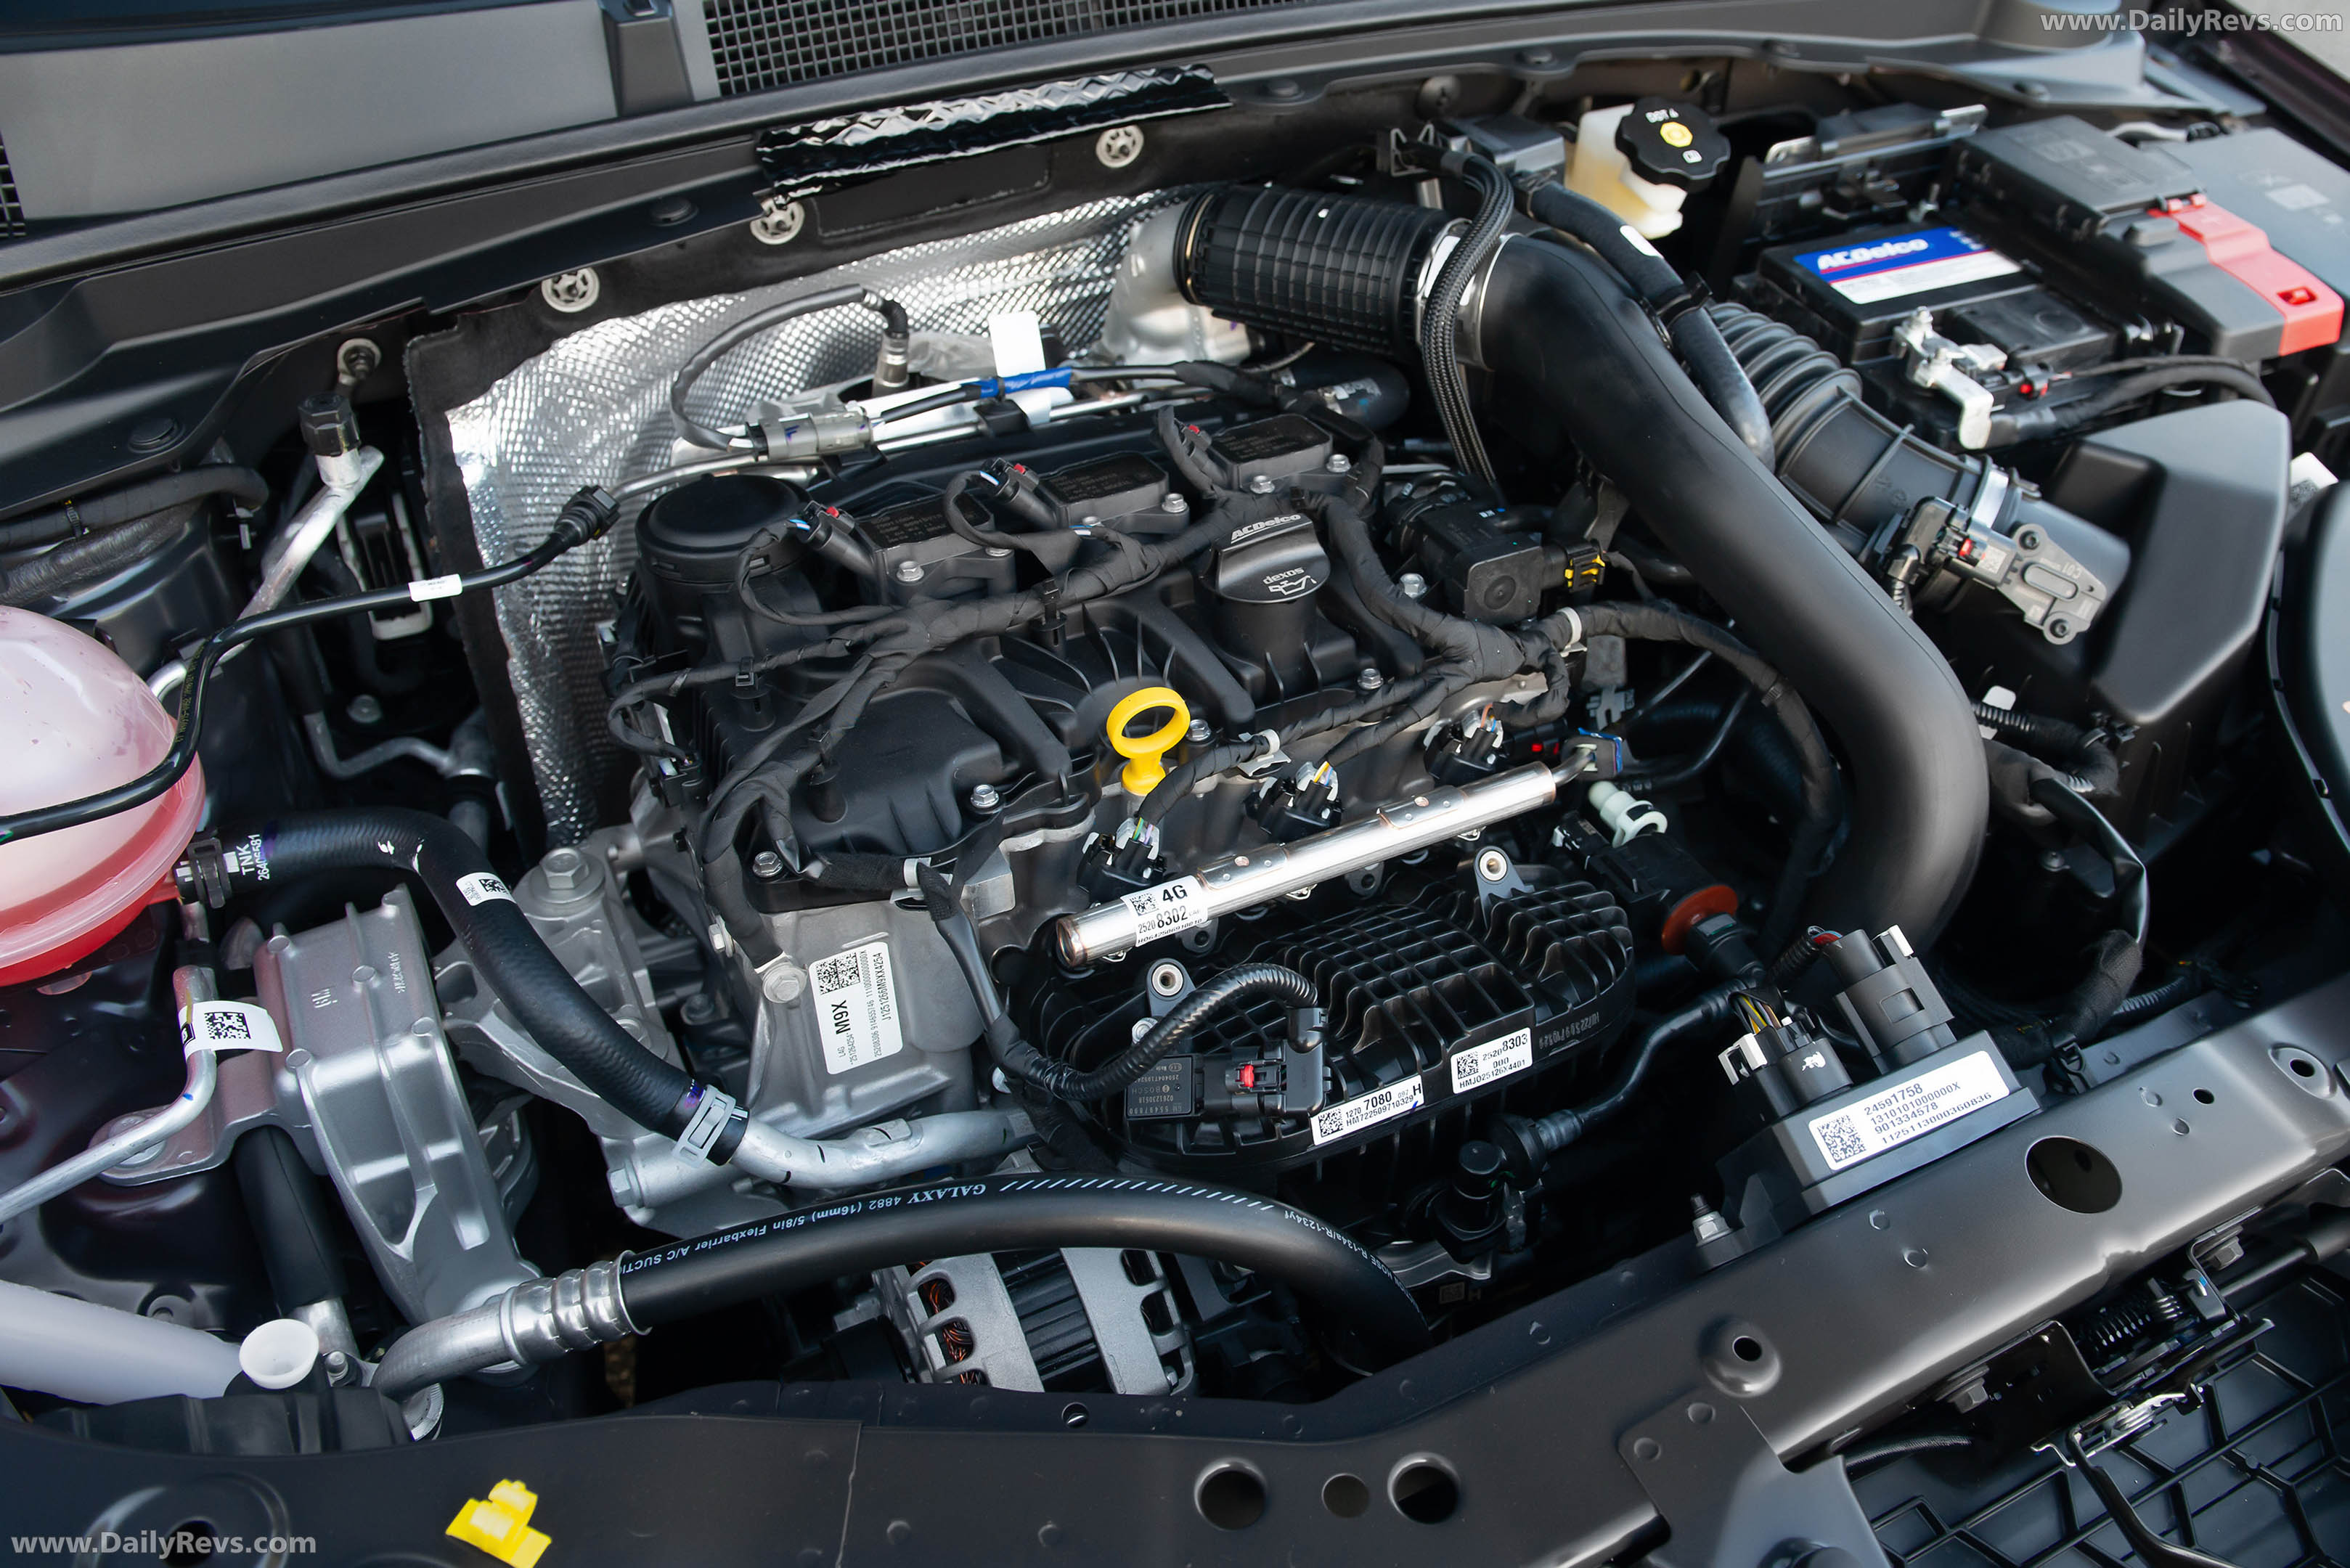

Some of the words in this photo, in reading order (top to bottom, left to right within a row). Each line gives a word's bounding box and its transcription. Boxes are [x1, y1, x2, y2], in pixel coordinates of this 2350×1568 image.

[1231, 514, 1302, 541] ACDelco
[1263, 567, 1305, 584] dexos
[236, 844, 255, 875] TNK
[1162, 885, 1188, 902] 4G
[873, 952, 892, 1021] J1251266M9XX4254
[831, 1000, 851, 1034] M9X
[837, 1046, 846, 1058] L4G
[1493, 1057, 1509, 1069] 000
[1132, 1086, 1162, 1095] BOSCH
[1345, 1107, 1361, 1118] 1270
[1363, 1091, 1392, 1110] 7080
[1413, 1083, 1422, 1095] H
[1864, 1083, 1924, 1116] 24591758
[1346, 1095, 1414, 1127] HM722509710329
[1870, 1082, 1962, 1125] 1310101000000X
[1874, 1102, 1938, 1134] 901334578
[1882, 1093, 1992, 1144] 1125113000360836
[868, 1196, 902, 1210] 4882
[907, 1183, 987, 1204] GALAXY
[772, 1215, 805, 1230] 5/8in
[812, 1201, 862, 1222] (16mm)
[694, 1225, 767, 1251] Flexbarrier
[619, 1254, 662, 1274] SUCTI
[666, 1246, 690, 1261] A/C
